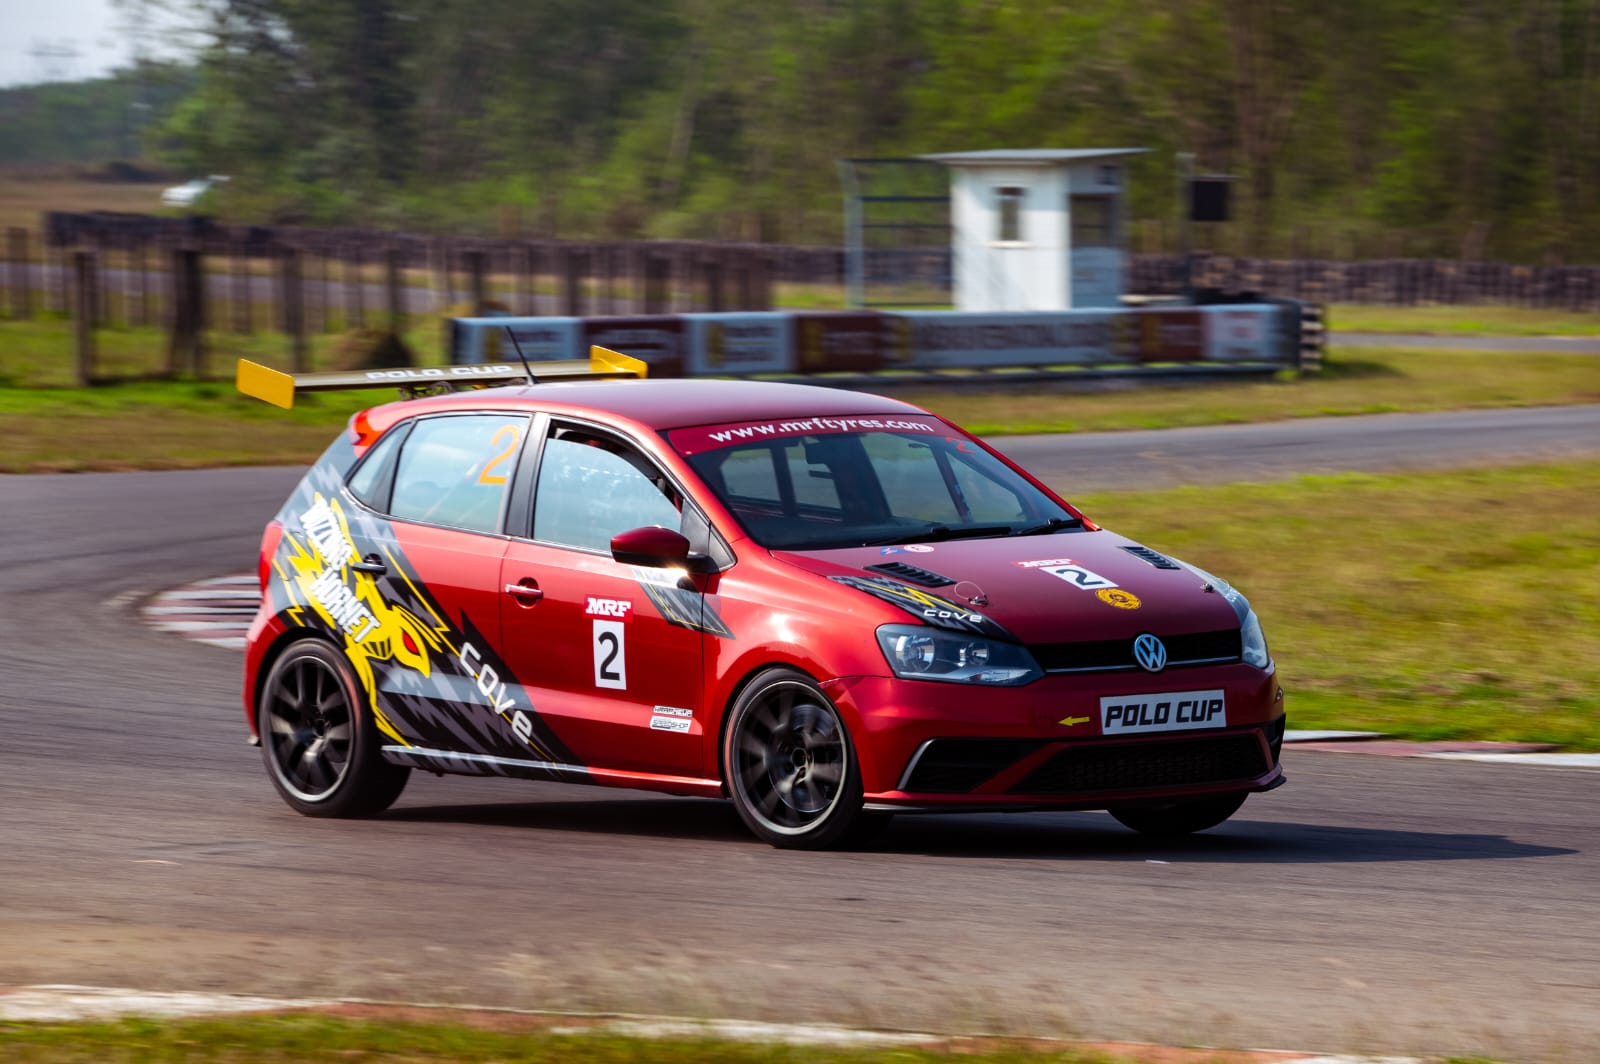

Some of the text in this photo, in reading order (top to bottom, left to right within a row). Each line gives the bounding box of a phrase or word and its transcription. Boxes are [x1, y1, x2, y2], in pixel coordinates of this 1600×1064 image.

[366, 366, 513, 380] POLO CUP
[708, 417, 934, 443] www.mrftyres.com
[478, 424, 520, 485] 2
[1055, 569, 1106, 586] 2
[310, 567, 380, 643] HORNET
[585, 597, 632, 617] MRF
[598, 631, 619, 681] 2
[1104, 699, 1223, 728] POLO CUP
